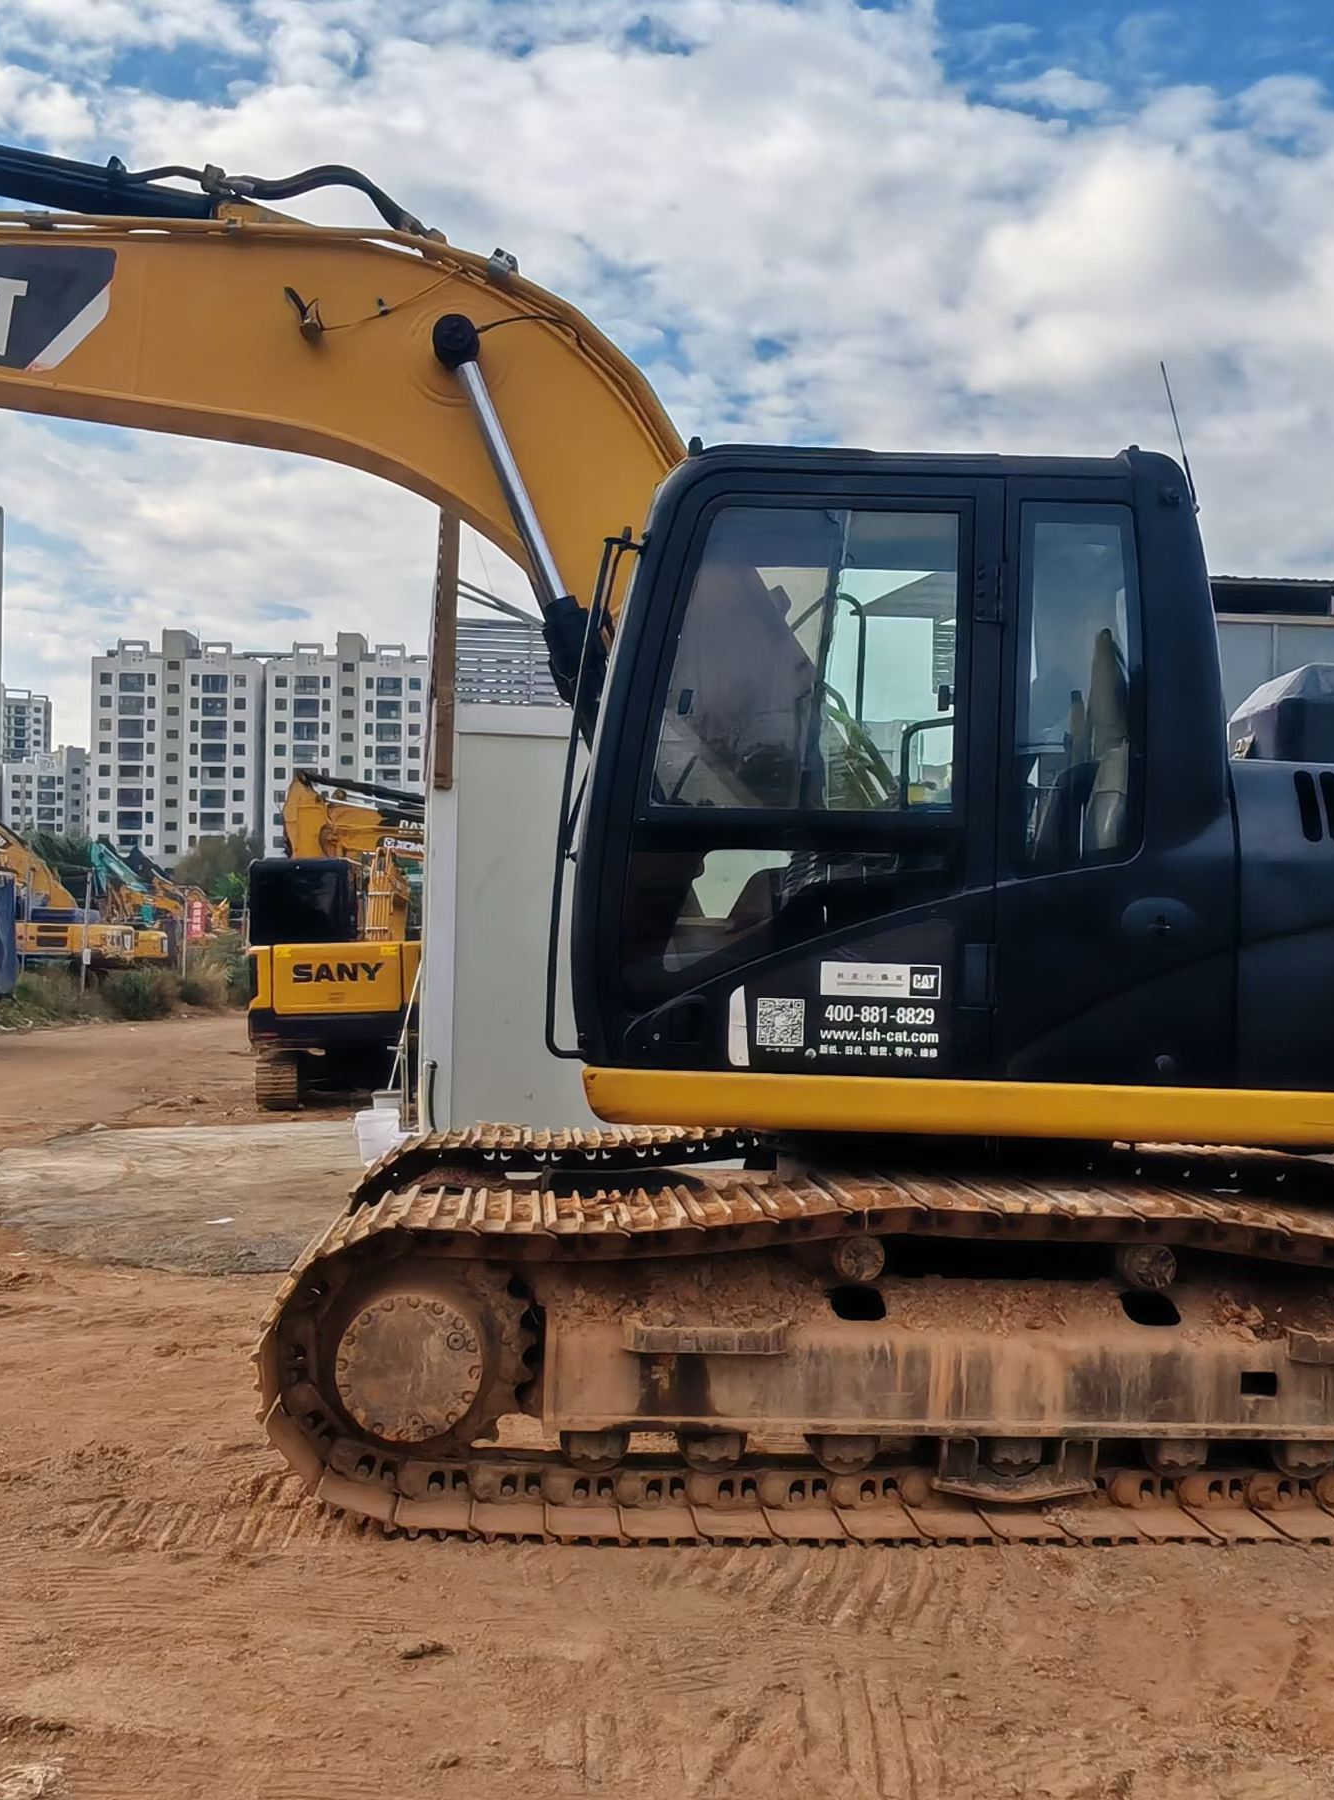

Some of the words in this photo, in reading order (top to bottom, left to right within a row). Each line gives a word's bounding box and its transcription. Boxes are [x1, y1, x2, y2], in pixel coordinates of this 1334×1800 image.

[292, 962, 384, 984] SANY
[913, 974, 938, 990] CAT
[824, 1004, 935, 1025] 400-881-8829
